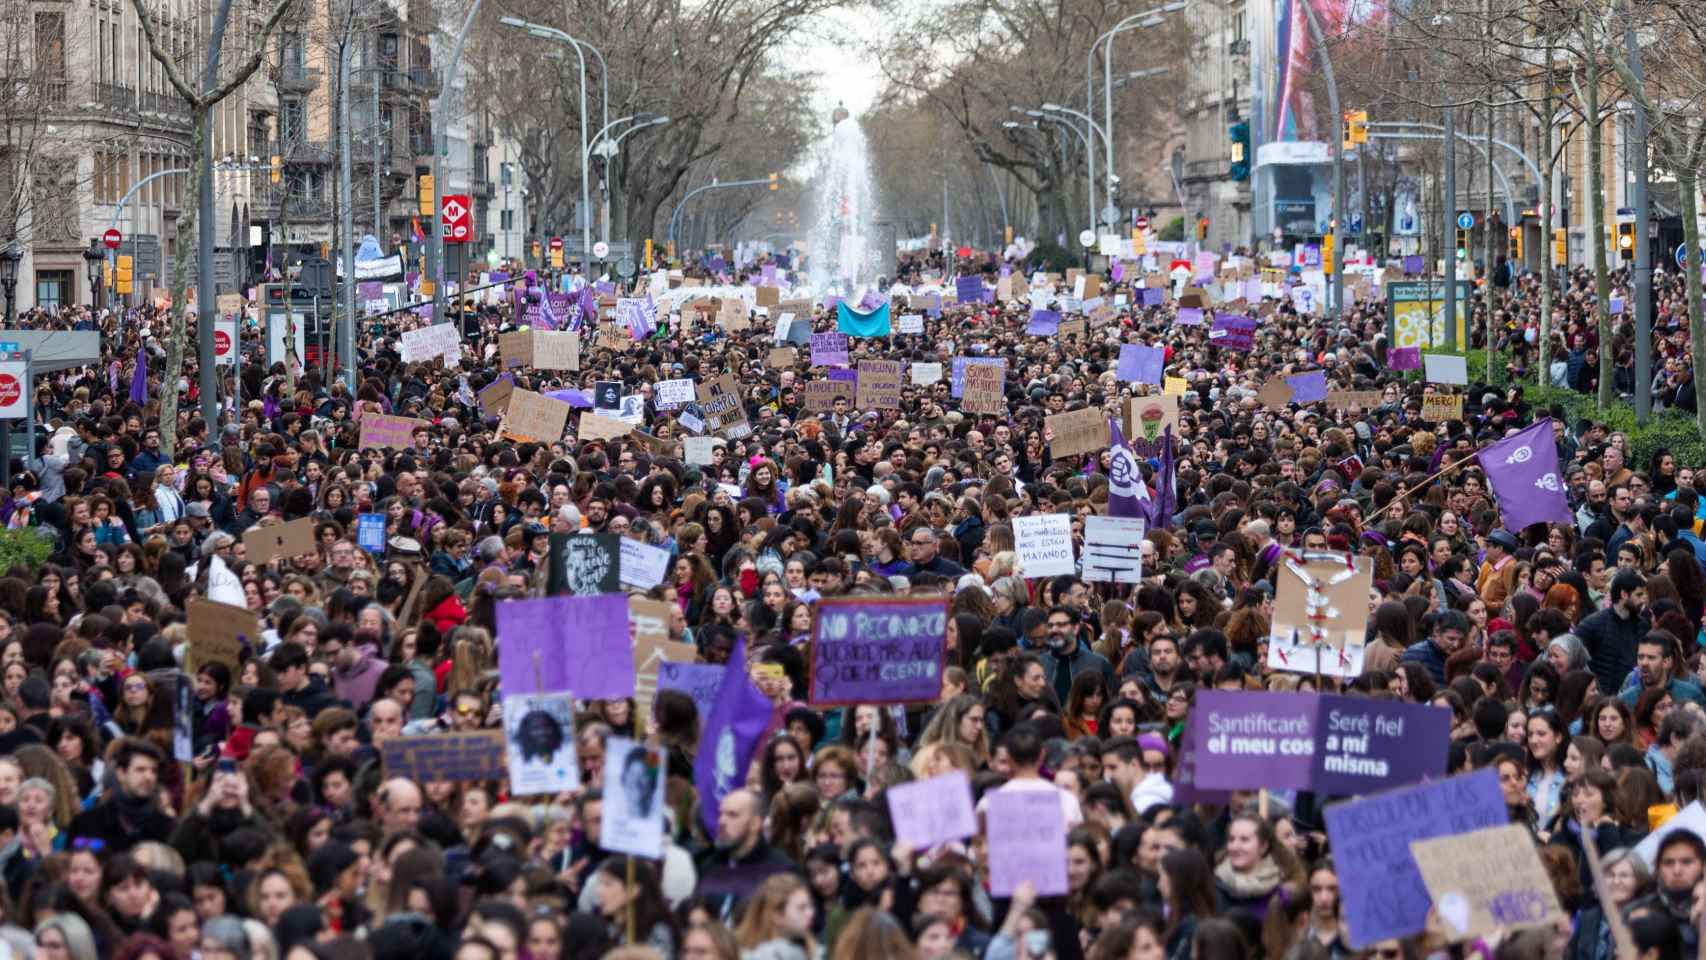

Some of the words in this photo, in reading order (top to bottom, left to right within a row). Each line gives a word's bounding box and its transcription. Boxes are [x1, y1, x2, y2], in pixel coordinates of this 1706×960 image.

[448, 206, 458, 216] M
[1023, 549, 1068, 562] MATANDO
[819, 613, 848, 641] NO
[853, 611, 946, 640] RECONOZCO
[1208, 712, 1308, 734] Santificaré
[1328, 711, 1369, 733] Seré
[1375, 715, 1404, 737] fiel
[1207, 736, 1227, 755] el
[1230, 739, 1275, 755] meu
[1279, 740, 1315, 756] cos
[1325, 737, 1338, 752] a
[1342, 734, 1369, 755] mí
[1324, 754, 1389, 777] misma
[1443, 780, 1480, 810] LAS
